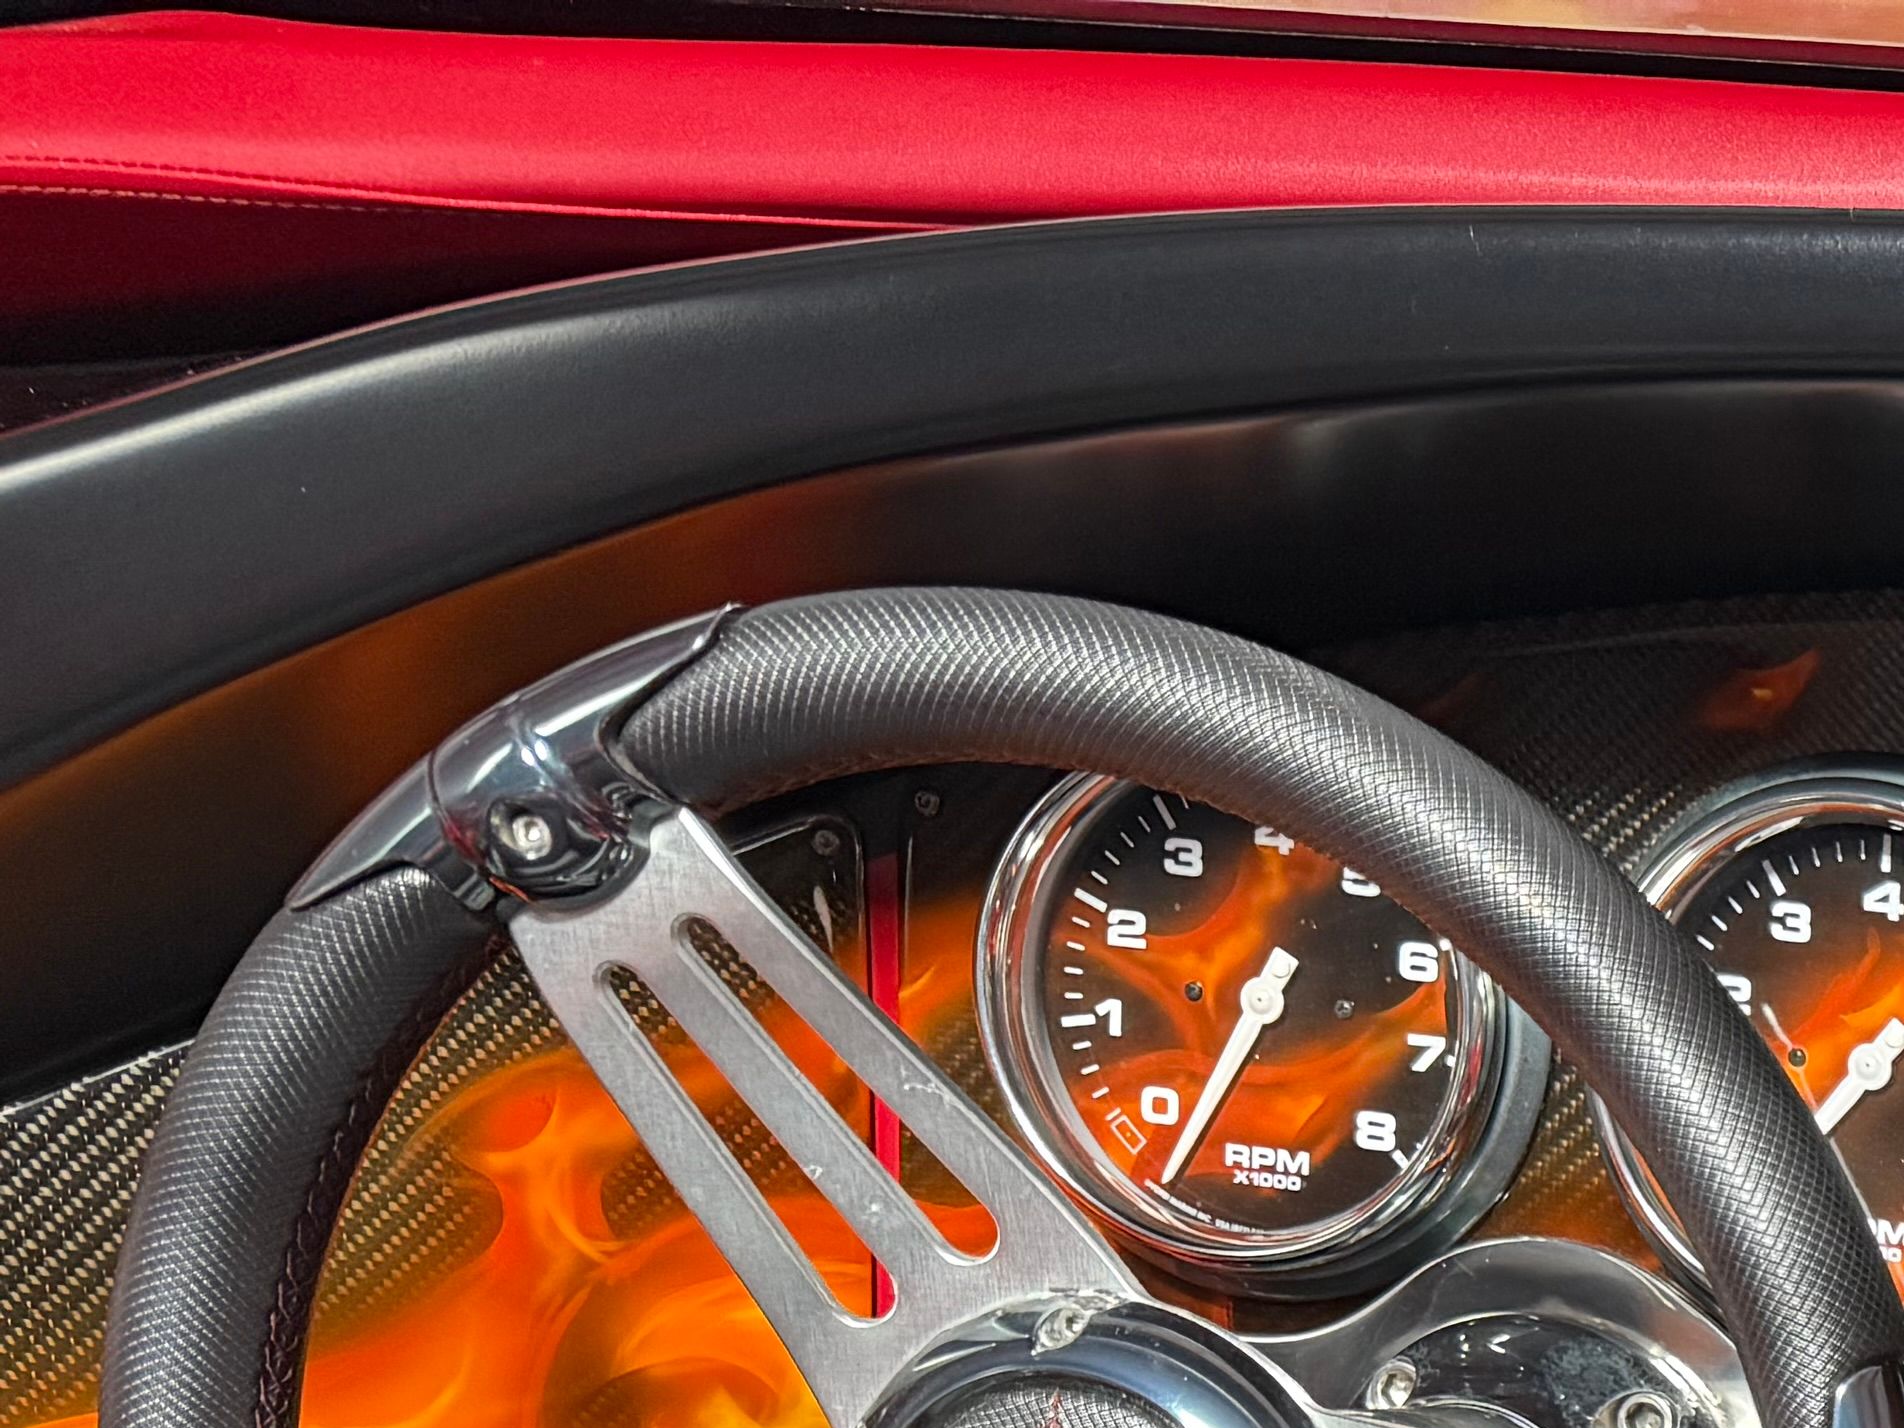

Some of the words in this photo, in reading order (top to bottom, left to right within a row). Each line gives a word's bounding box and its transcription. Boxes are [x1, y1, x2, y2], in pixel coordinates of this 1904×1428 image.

[1164, 837, 1203, 877] 3
[1862, 881, 1904, 922] 4
[1106, 909, 1147, 950] 2
[1770, 902, 1812, 943] 3
[1398, 942, 1439, 983] 6
[1094, 999, 1123, 1037] 1
[1406, 1033, 1446, 1072] 7
[1140, 1085, 1179, 1126] 0
[1355, 1111, 1397, 1152] 8
[1225, 1142, 1310, 1176] RPM
[1233, 1169, 1302, 1192] X1000
